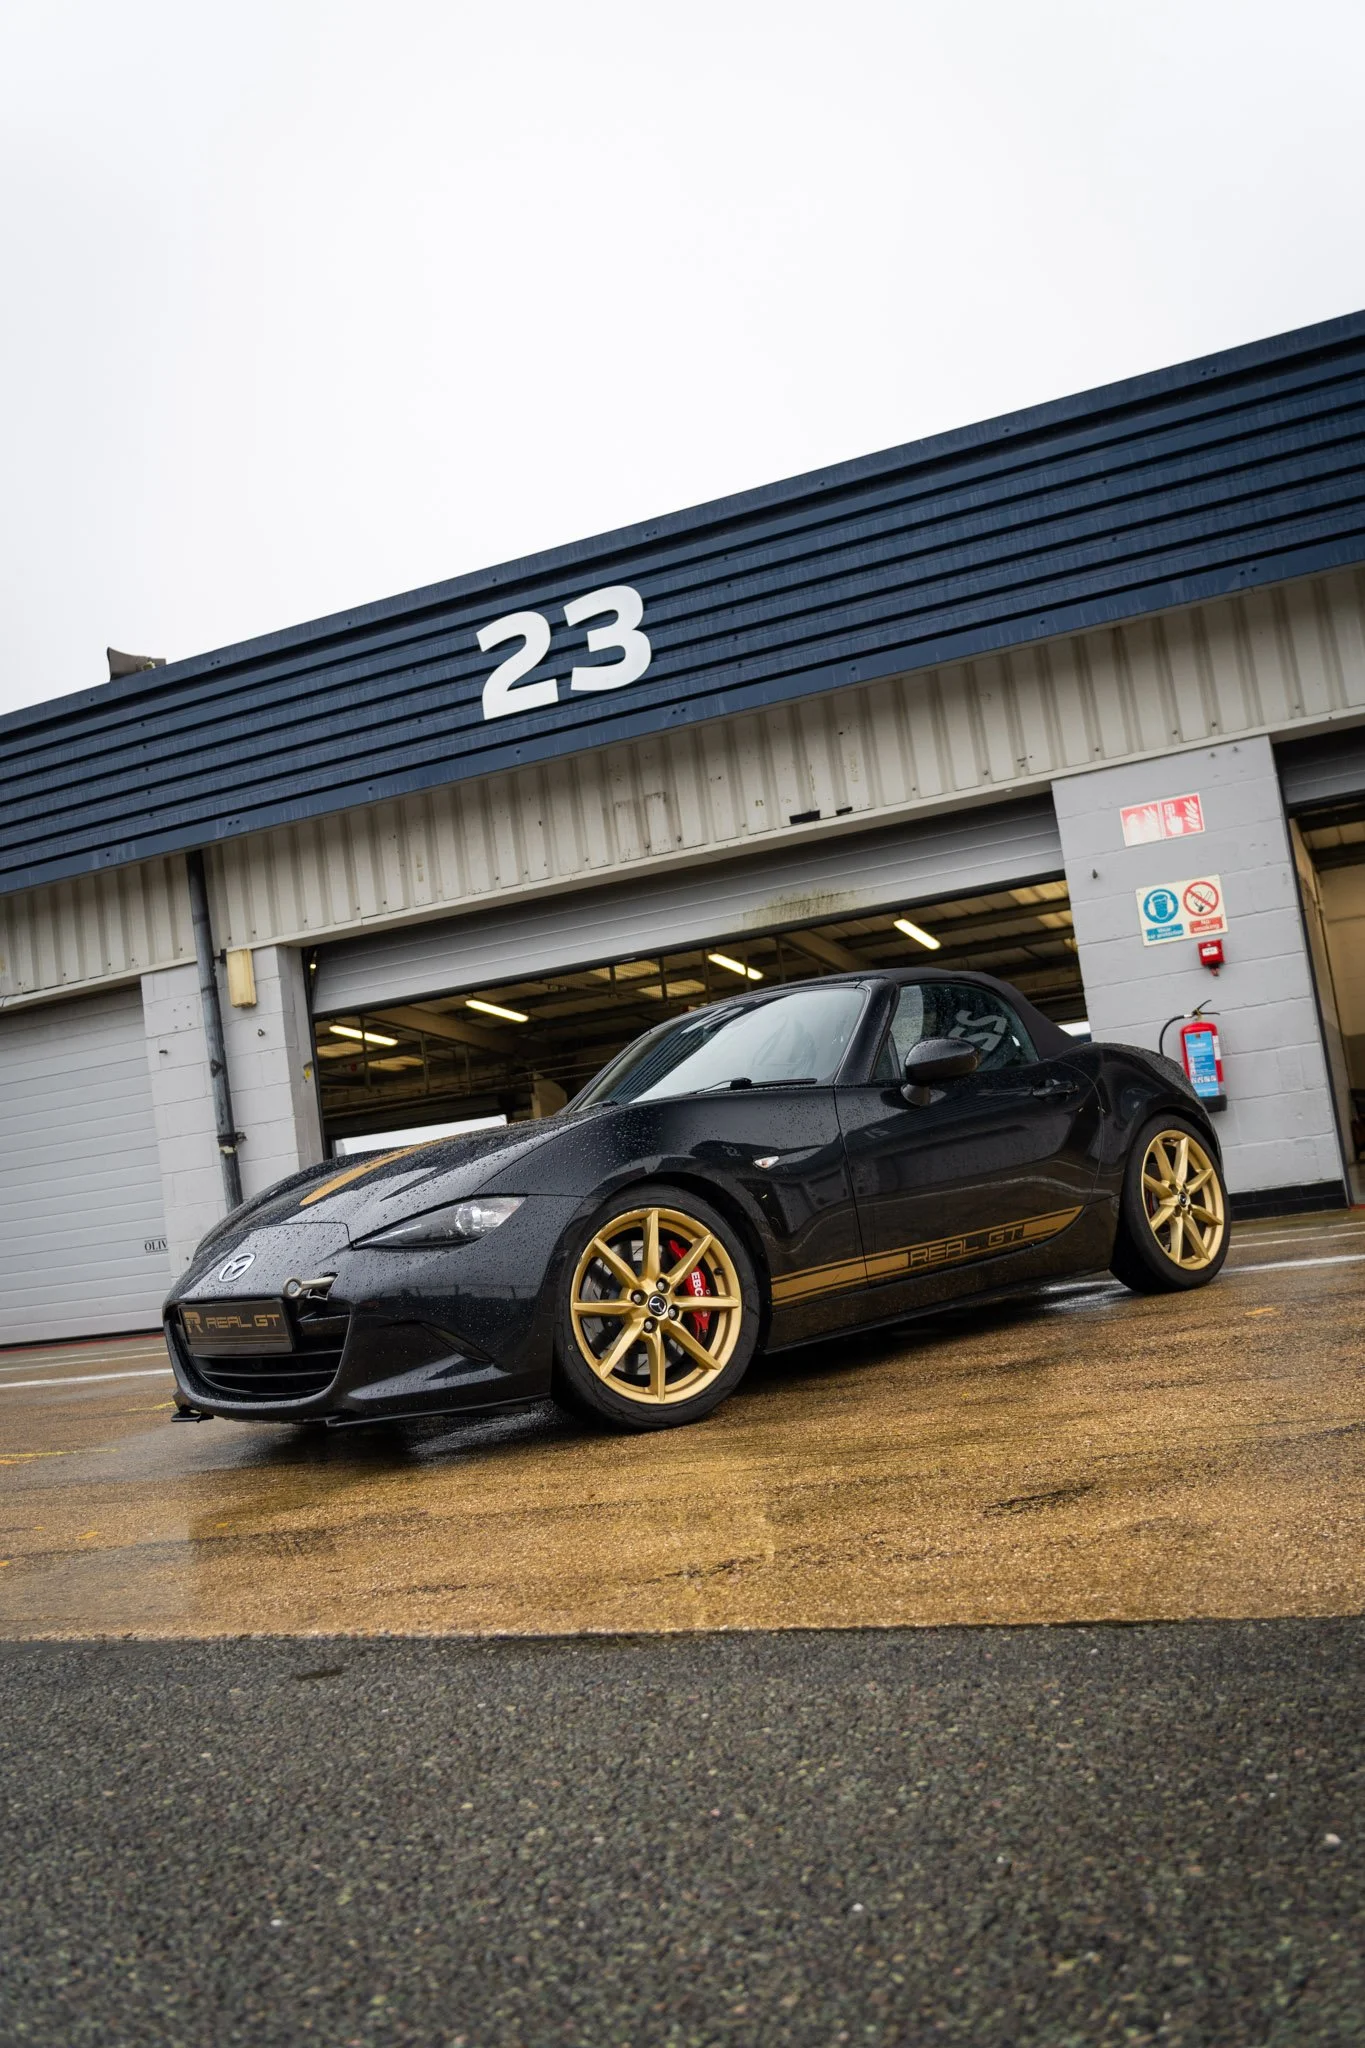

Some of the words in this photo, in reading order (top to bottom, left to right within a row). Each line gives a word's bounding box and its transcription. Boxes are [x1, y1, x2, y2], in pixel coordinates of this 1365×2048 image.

[476, 585, 651, 720] 23
[910, 1239, 979, 1266] REAL
[988, 1225, 1024, 1246] GT
[691, 1271, 703, 1297] EBC
[205, 1315, 252, 1329] REAL
[254, 1314, 280, 1327] GT
